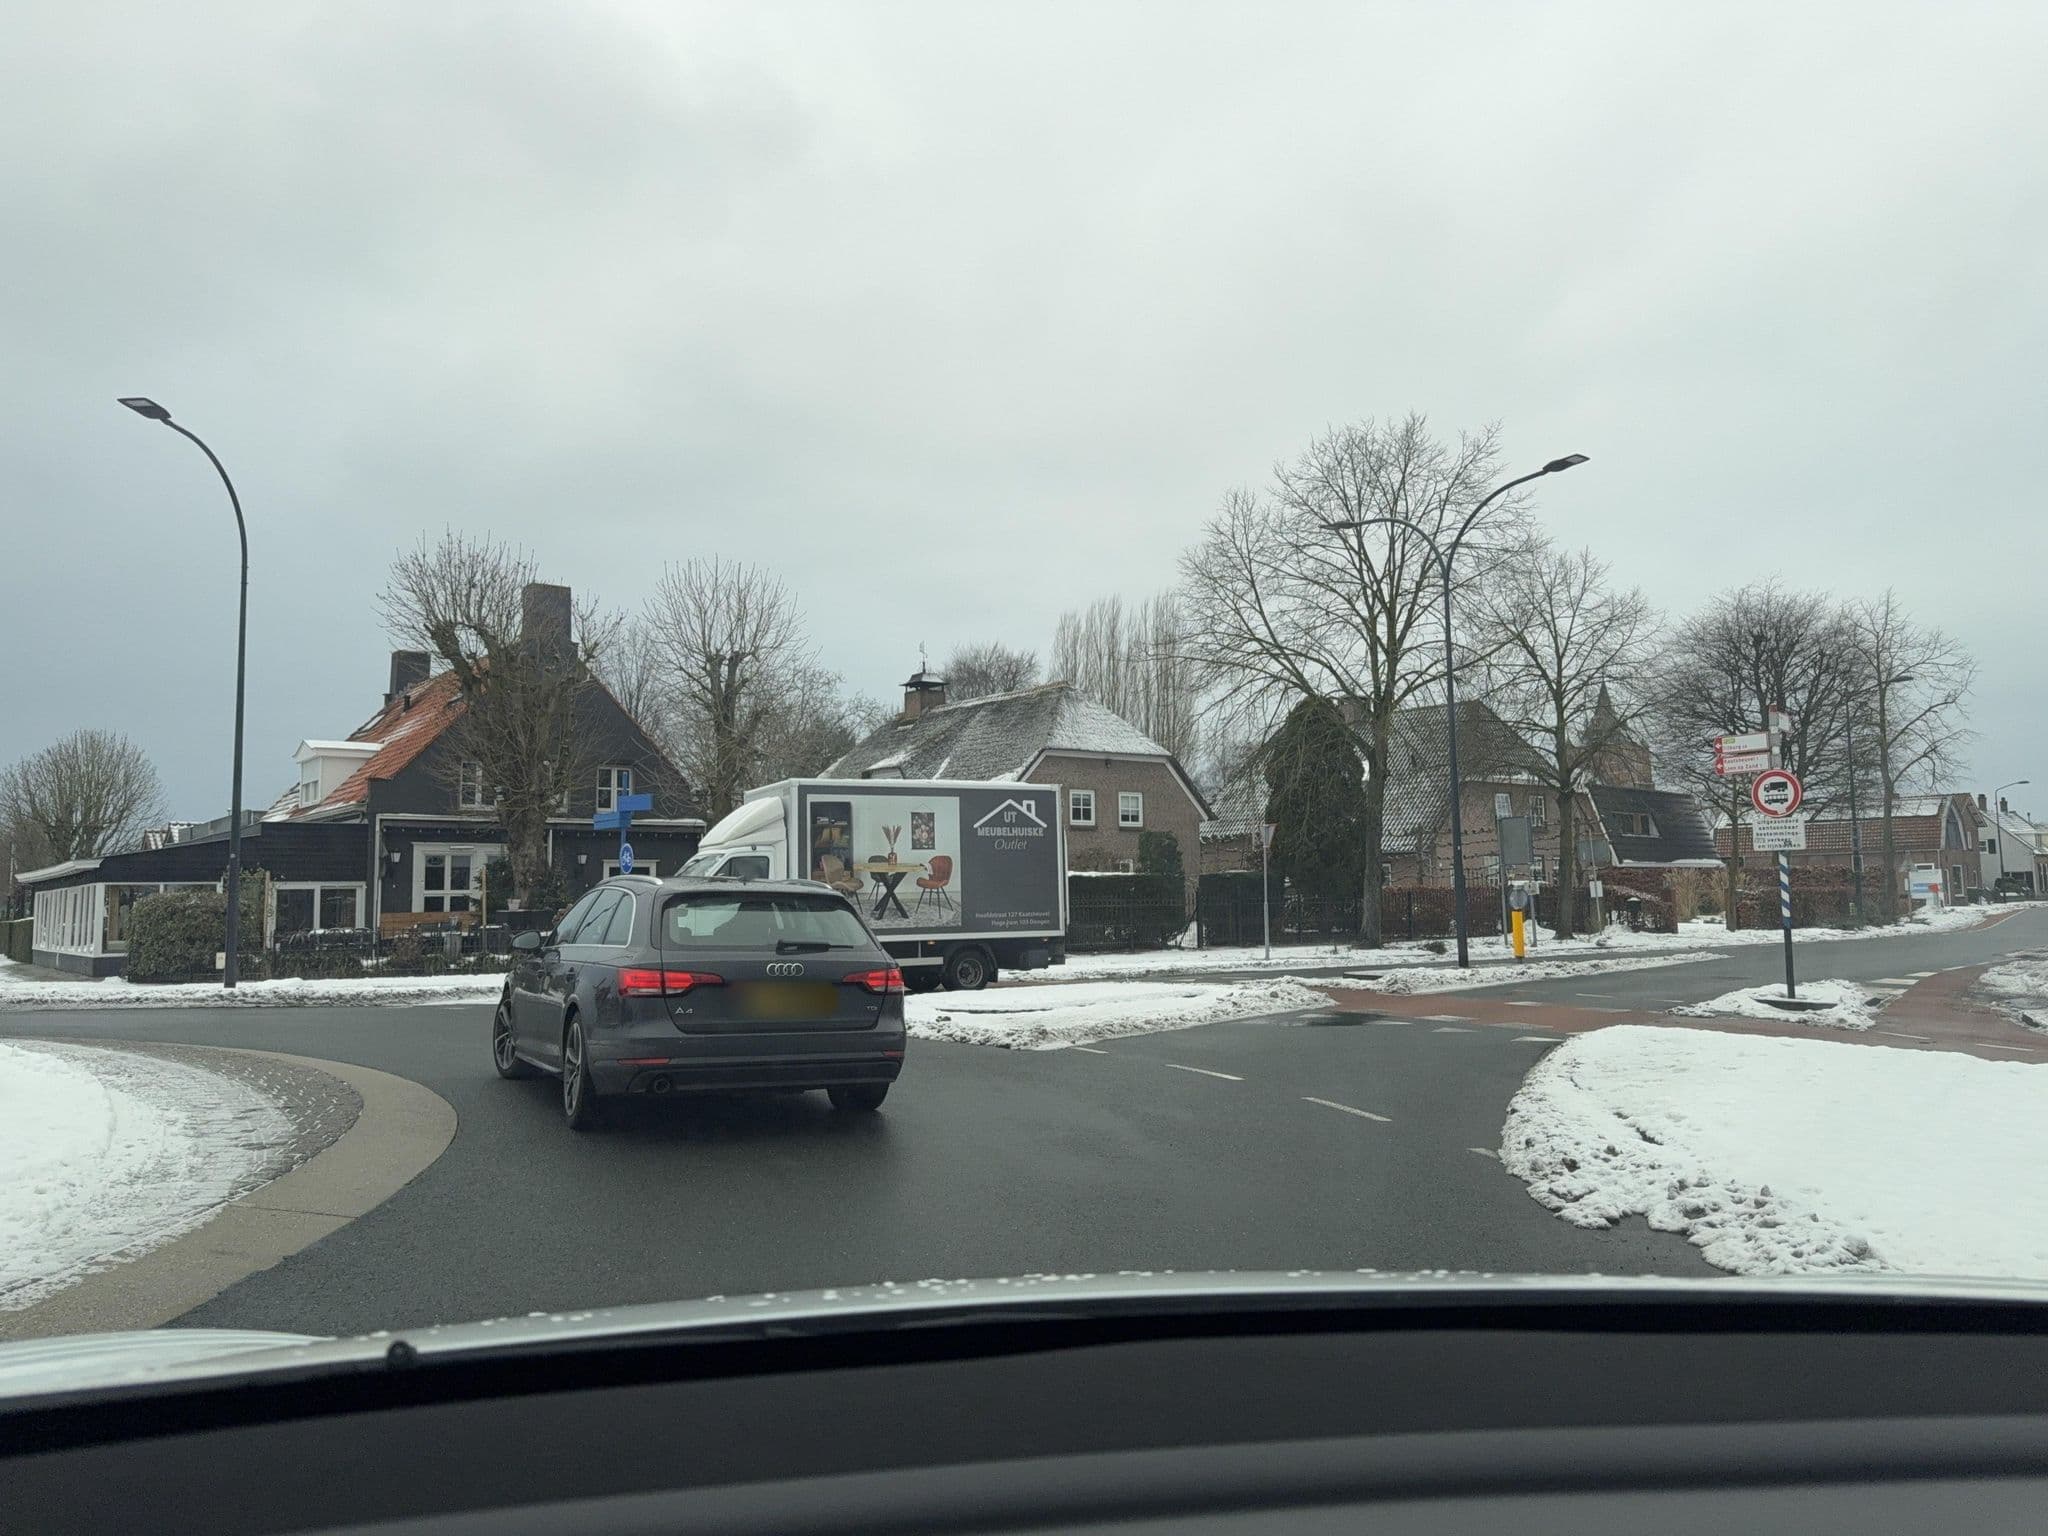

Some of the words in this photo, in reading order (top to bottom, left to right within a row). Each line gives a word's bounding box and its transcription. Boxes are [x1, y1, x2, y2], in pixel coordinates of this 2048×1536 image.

[1003, 811, 1017, 823] UT
[977, 826, 1044, 837] MEUBELHUISKE
[994, 838, 1027, 850] Outlet
